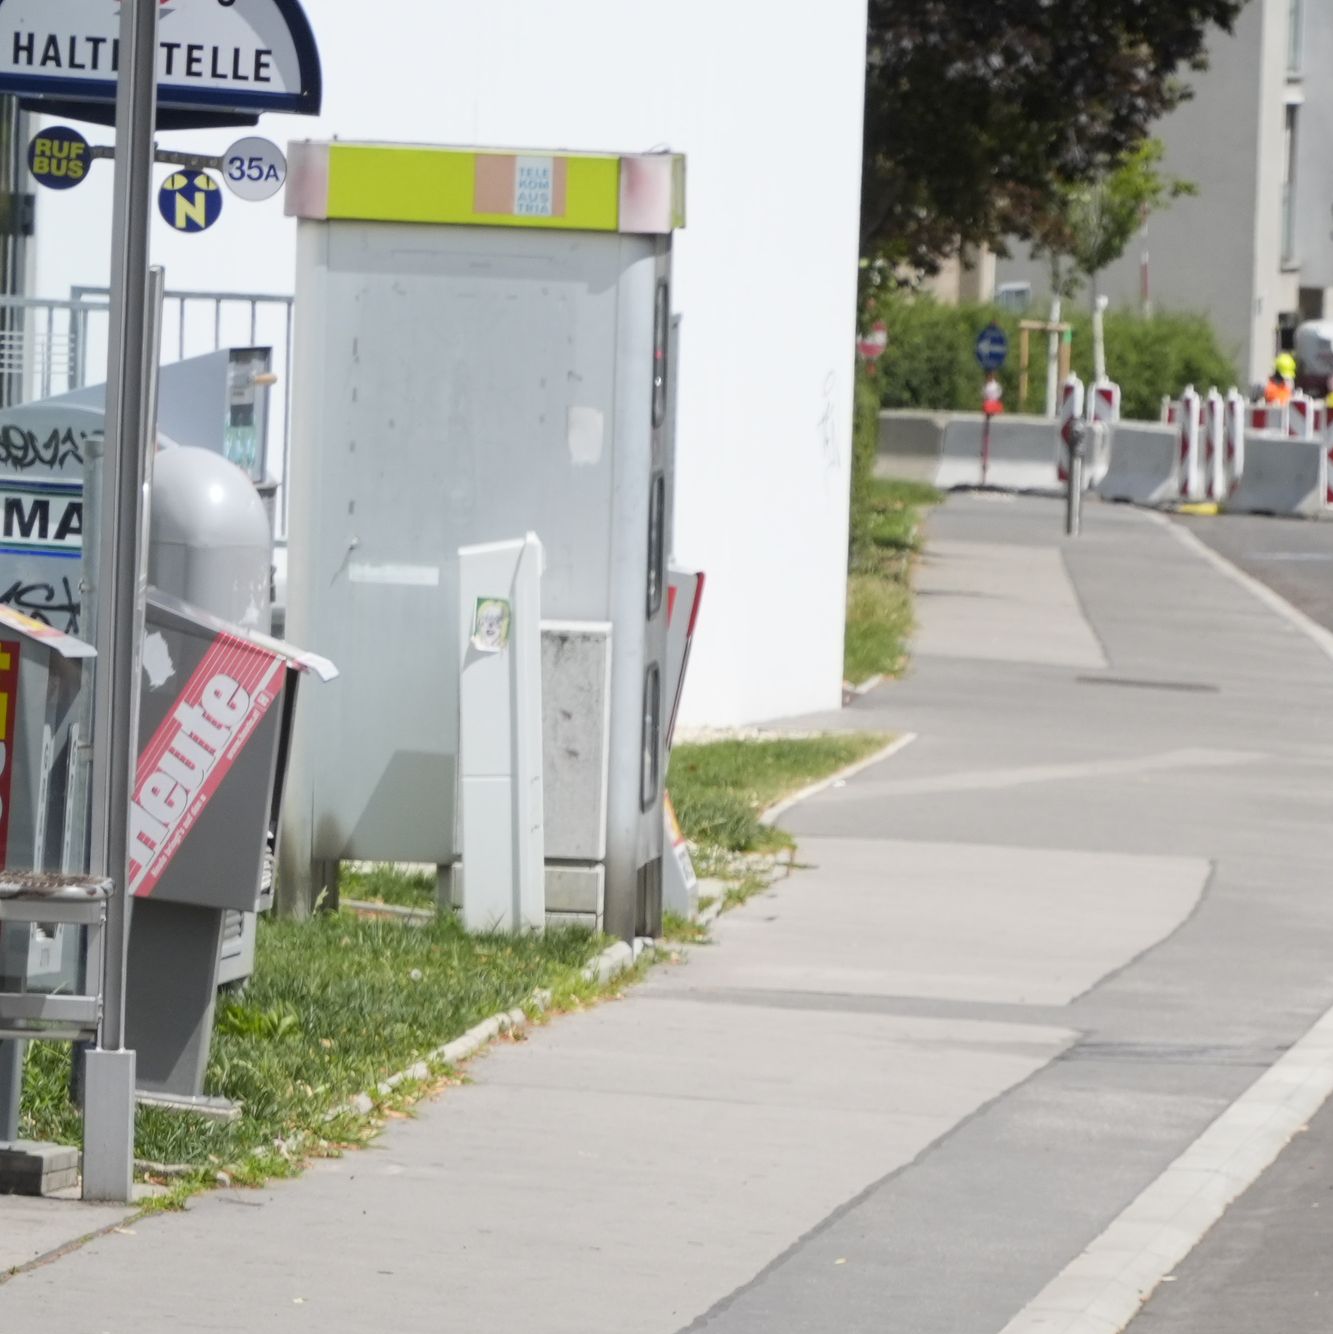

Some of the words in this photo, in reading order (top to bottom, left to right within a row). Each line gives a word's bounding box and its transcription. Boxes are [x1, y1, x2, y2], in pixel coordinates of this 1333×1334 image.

[12, 31, 273, 83] HALTTELLE
[35, 138, 86, 160] RUF
[33, 157, 85, 179] BUS
[228, 157, 280, 182] 35A
[519, 167, 549, 178] TELE
[175, 191, 206, 229] N
